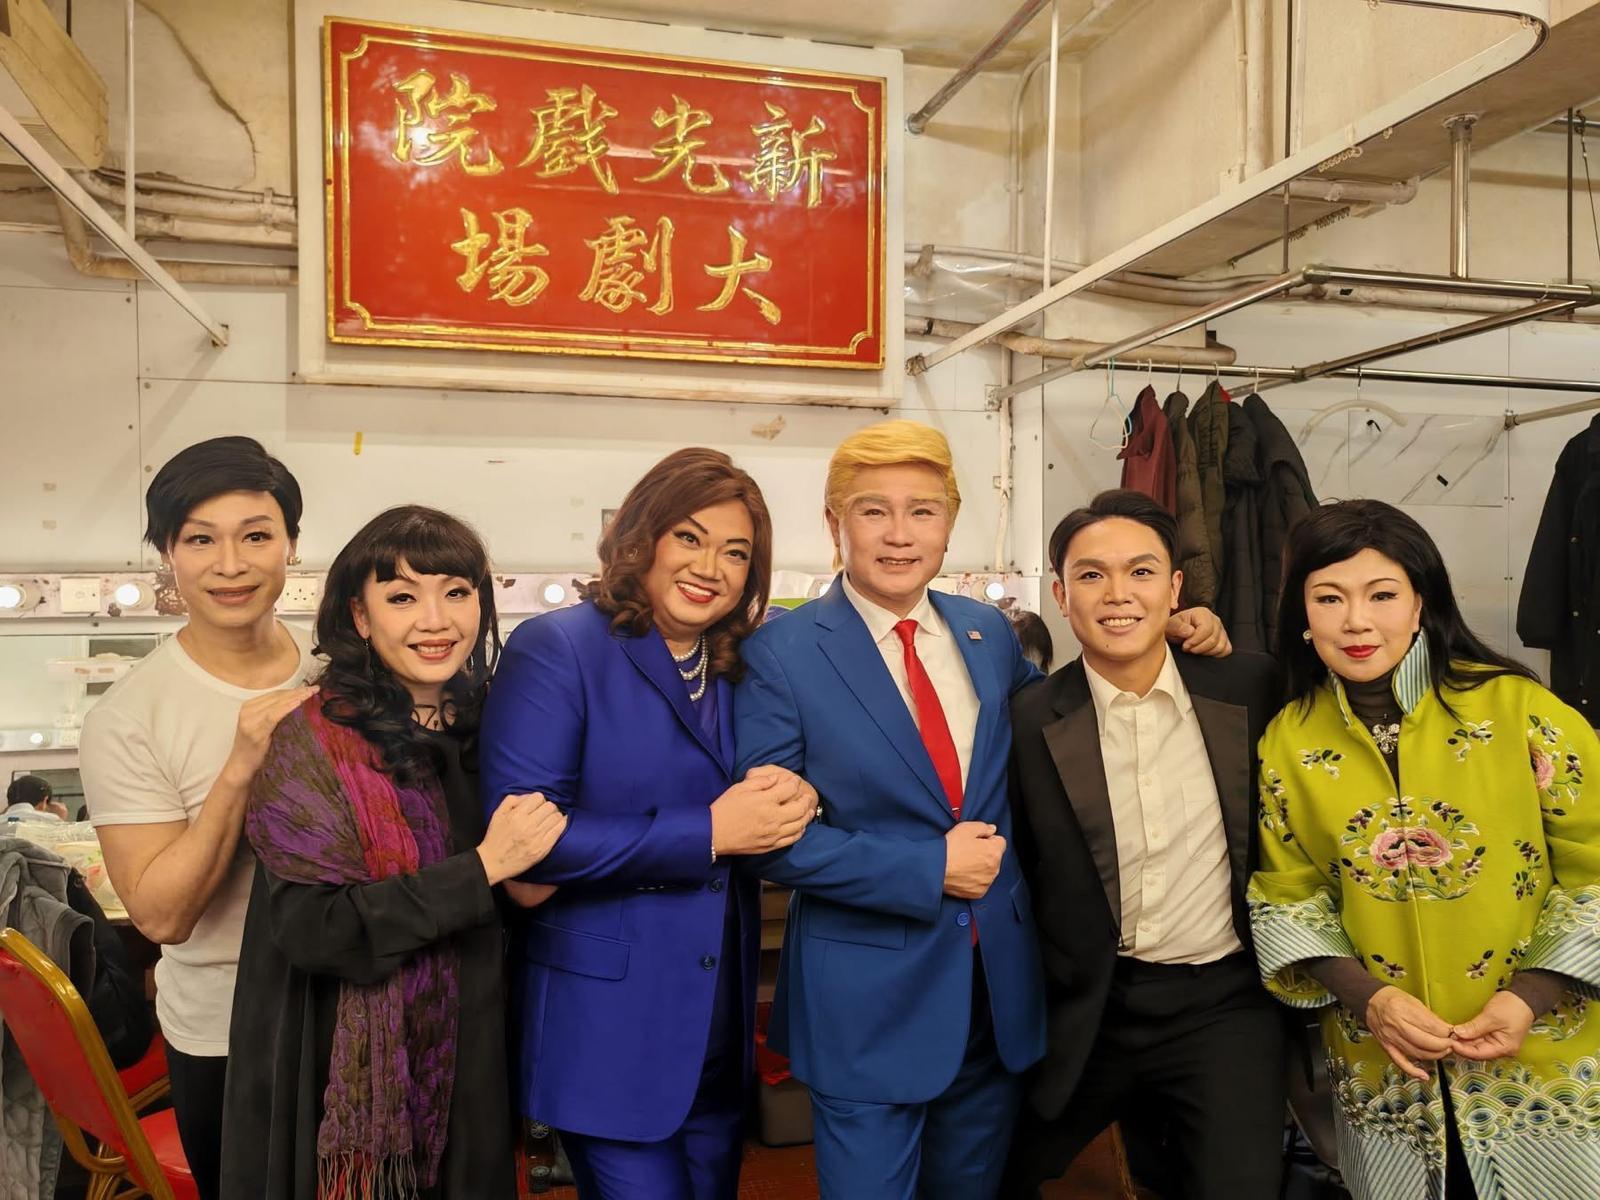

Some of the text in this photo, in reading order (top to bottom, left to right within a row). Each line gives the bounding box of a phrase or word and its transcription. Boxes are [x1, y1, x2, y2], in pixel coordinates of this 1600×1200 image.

[392, 69, 837, 209] 新光戲院
[451, 207, 782, 325] 大劇場
